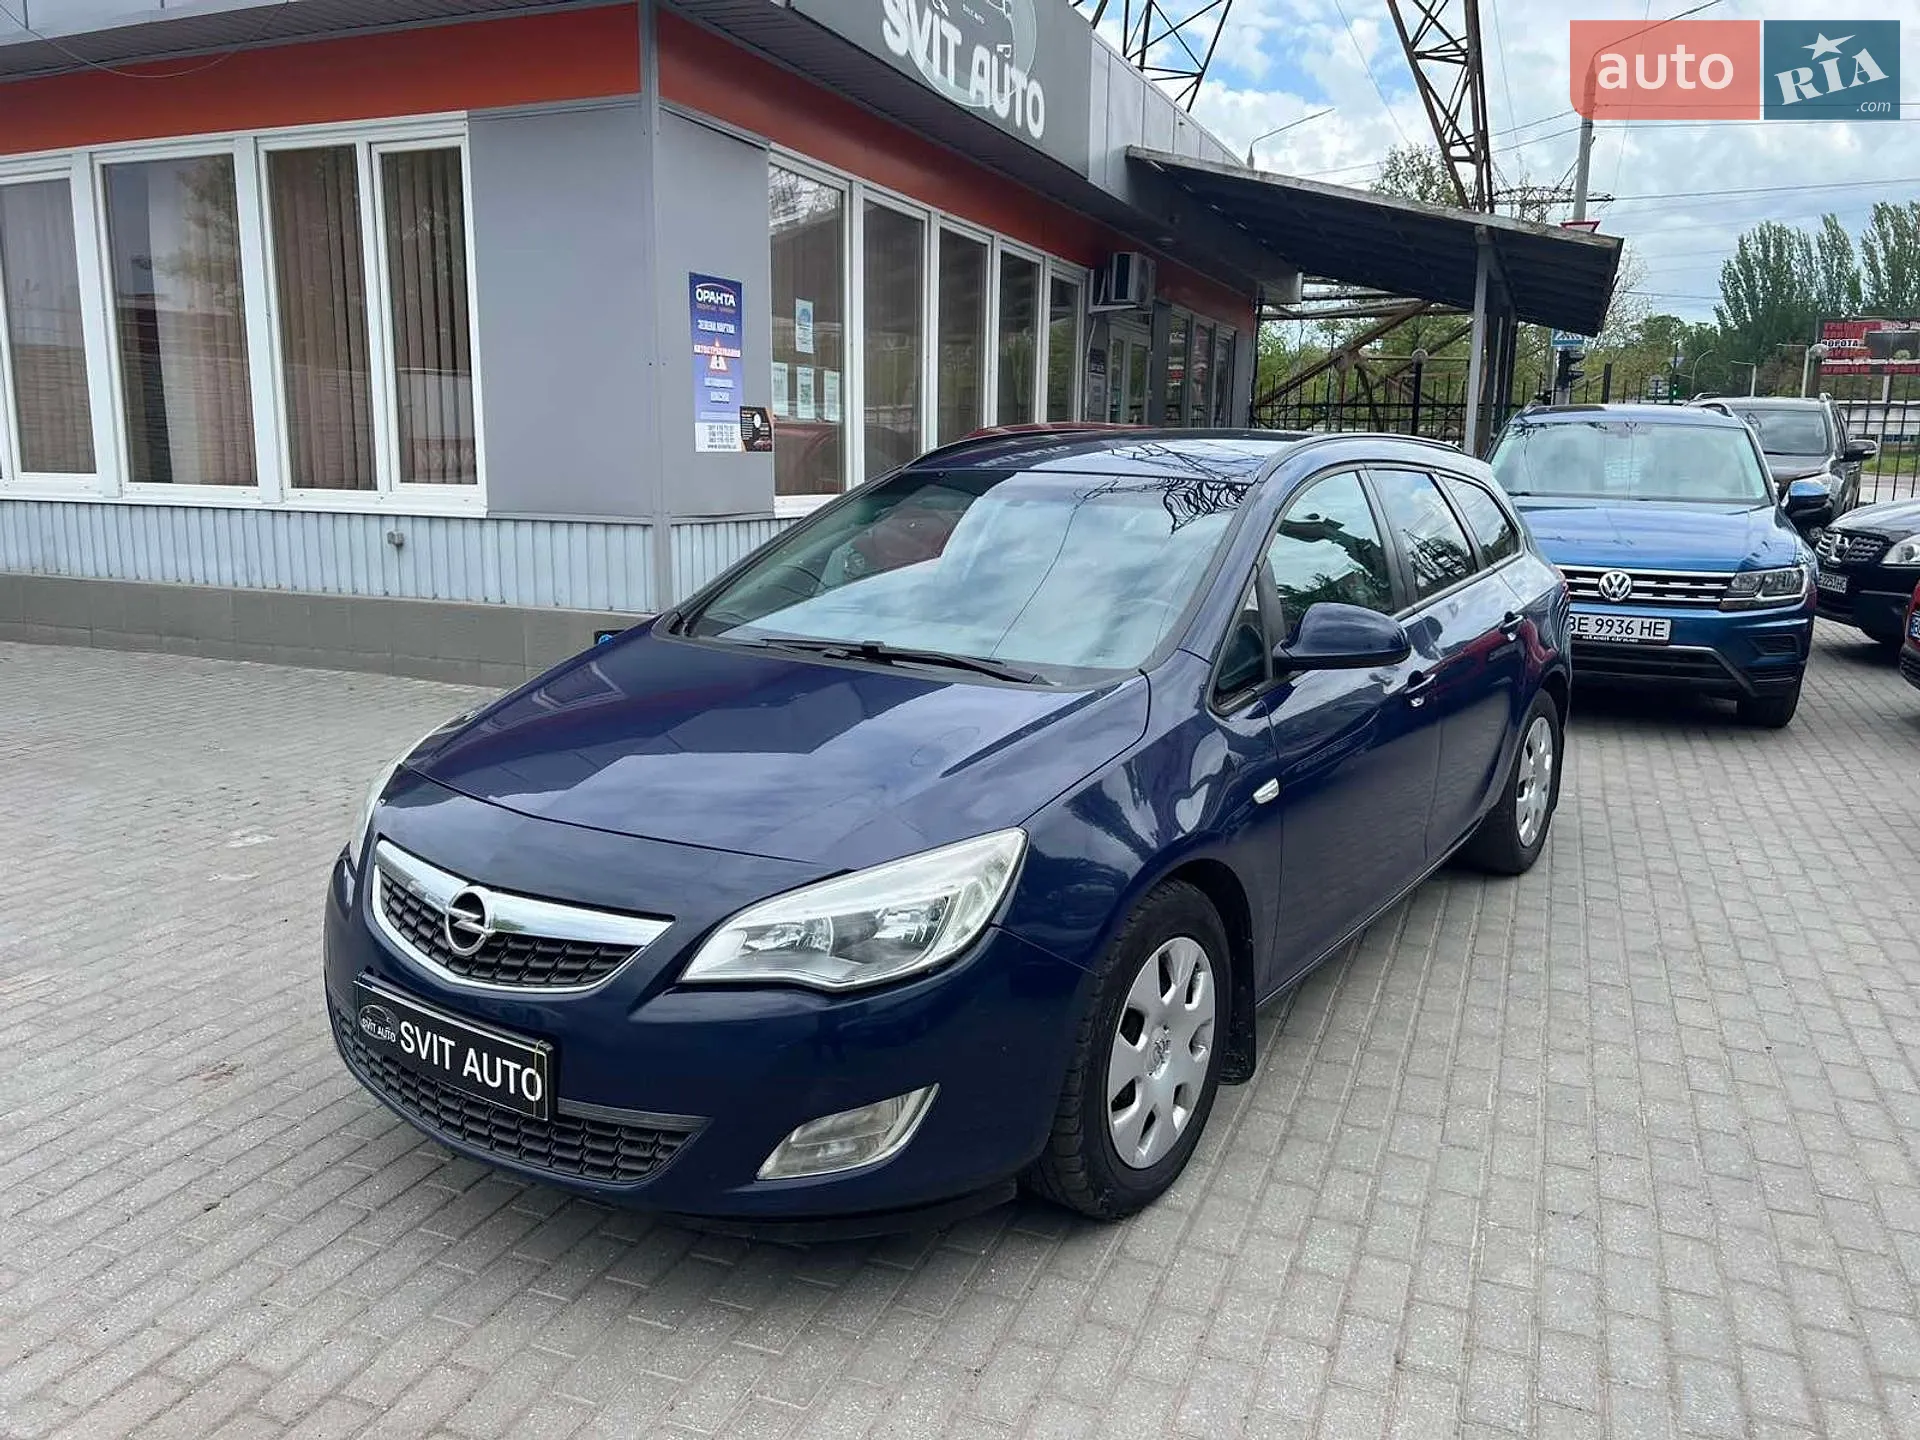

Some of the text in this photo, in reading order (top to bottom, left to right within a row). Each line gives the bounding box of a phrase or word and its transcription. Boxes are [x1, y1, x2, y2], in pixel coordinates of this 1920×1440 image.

[882, 0, 1045, 139] SVIT AUTO
[695, 288, 736, 307] ОРАНТА
[1594, 617, 1635, 635] 9936
[1640, 620, 1666, 637] HE
[377, 1025, 396, 1043] AUTO
[400, 1020, 543, 1101] SVIT AUTO
